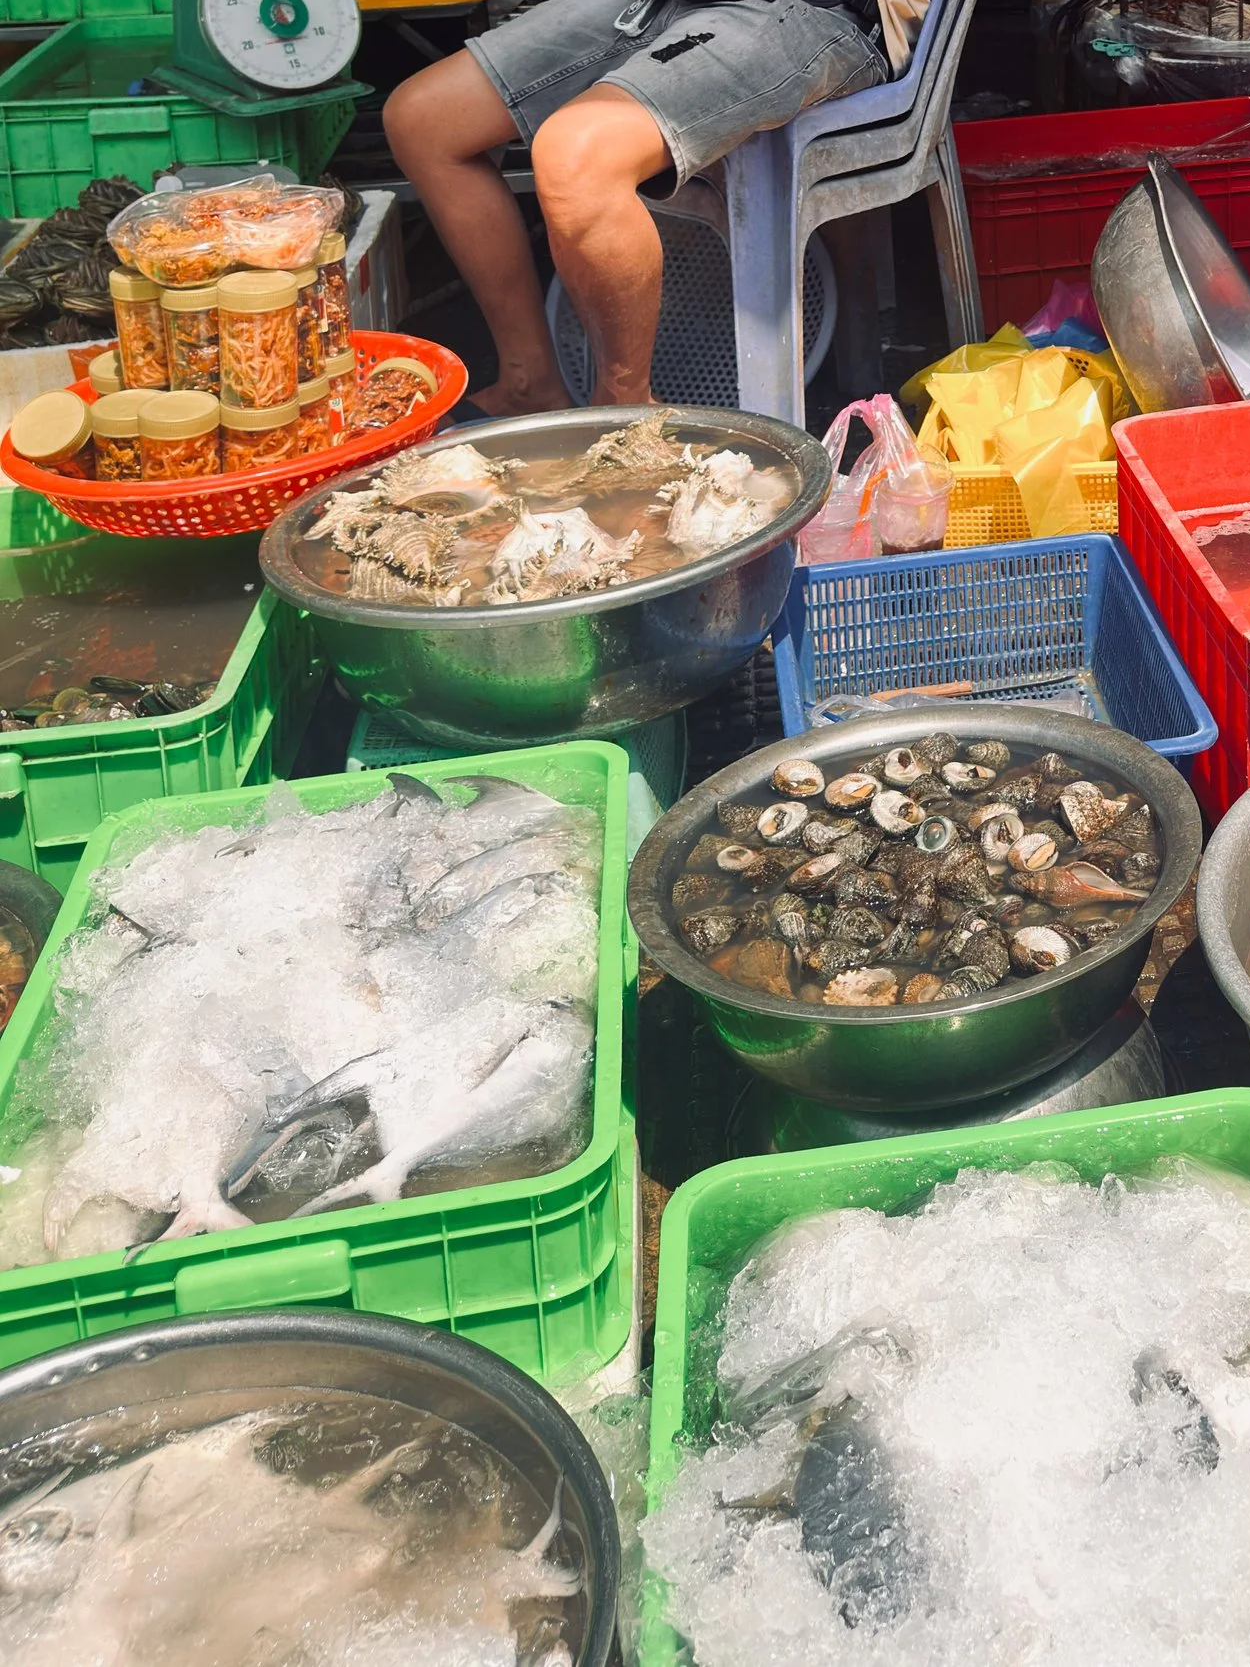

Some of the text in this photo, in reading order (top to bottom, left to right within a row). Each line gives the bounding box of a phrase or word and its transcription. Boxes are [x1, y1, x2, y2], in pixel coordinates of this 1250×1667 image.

[313, 27, 326, 36] 10
[242, 40, 254, 50] 20
[288, 59, 301, 69] 15
